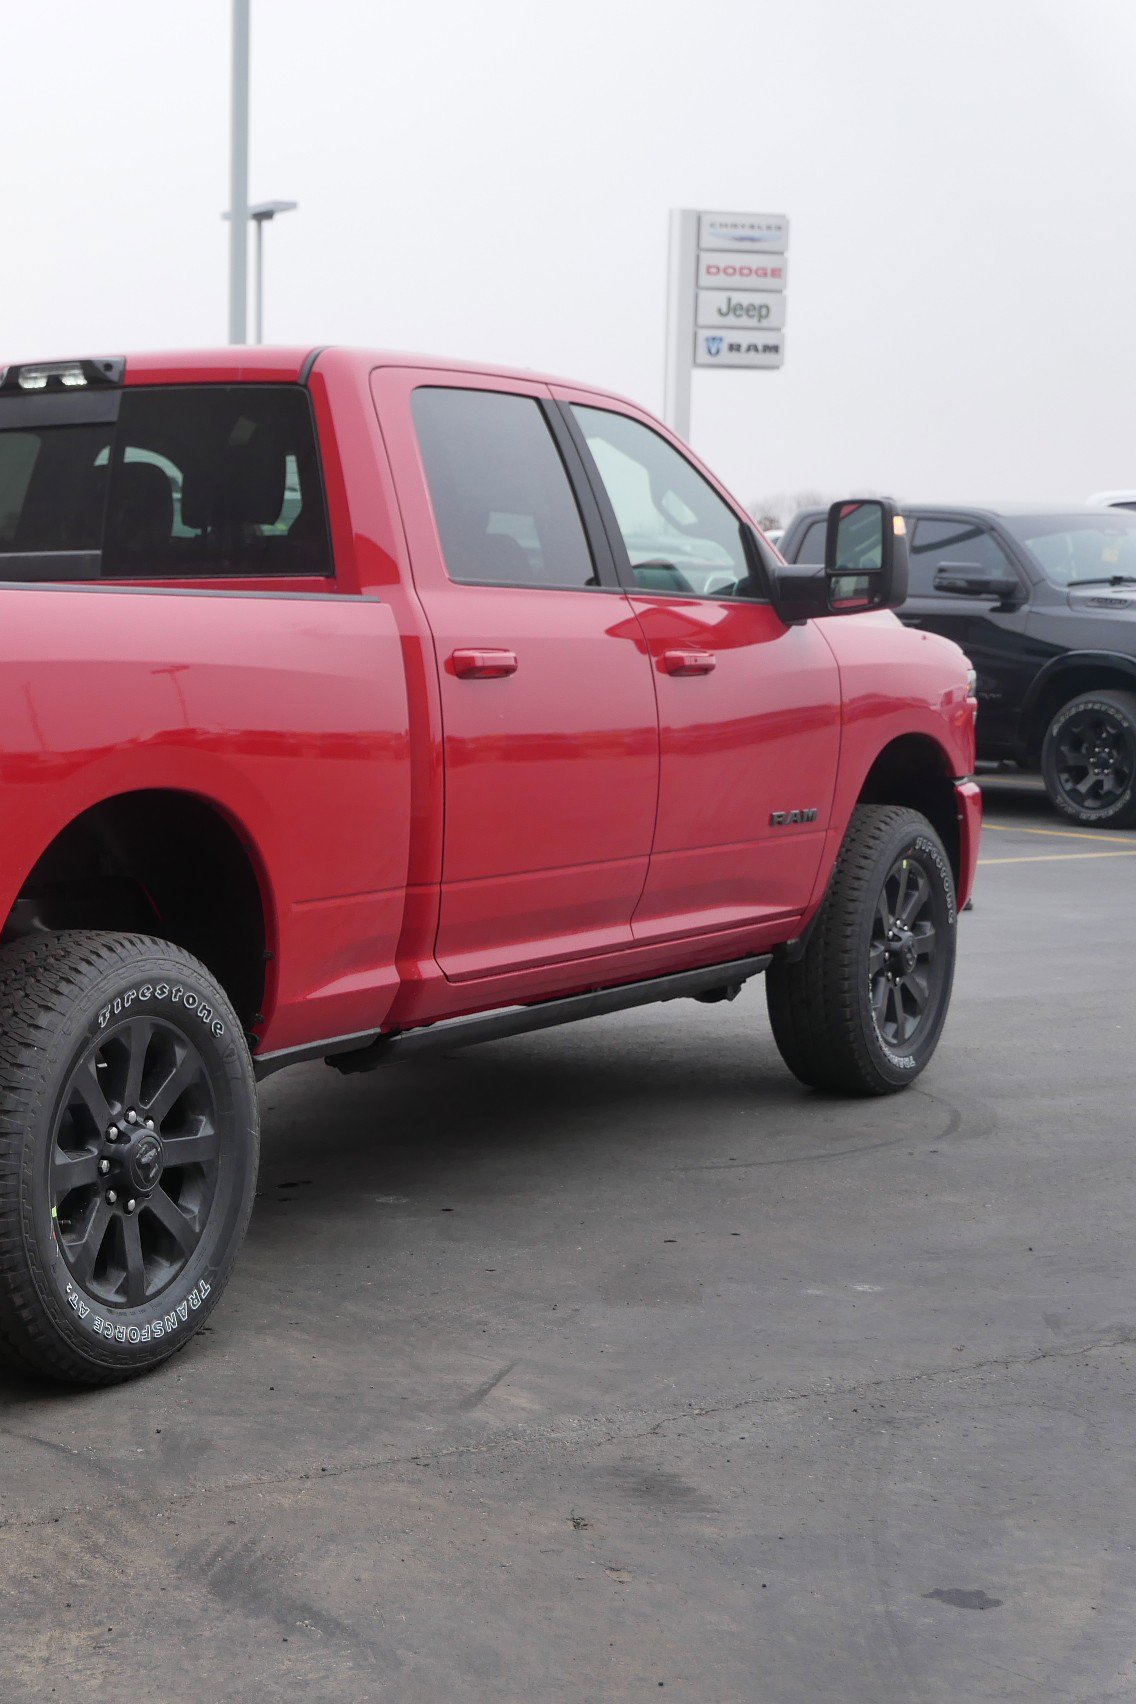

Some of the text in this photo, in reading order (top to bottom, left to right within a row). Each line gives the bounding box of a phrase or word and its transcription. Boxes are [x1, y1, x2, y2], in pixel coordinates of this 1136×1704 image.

[709, 222, 782, 231] CHRYSLER
[706, 265, 783, 279] DODGE
[717, 296, 770, 322] Jeep
[728, 343, 779, 354] RAM
[769, 808, 818, 826] RAM
[99, 983, 224, 1037] Firestone
[93, 1280, 211, 1343] TRANSFORCE
